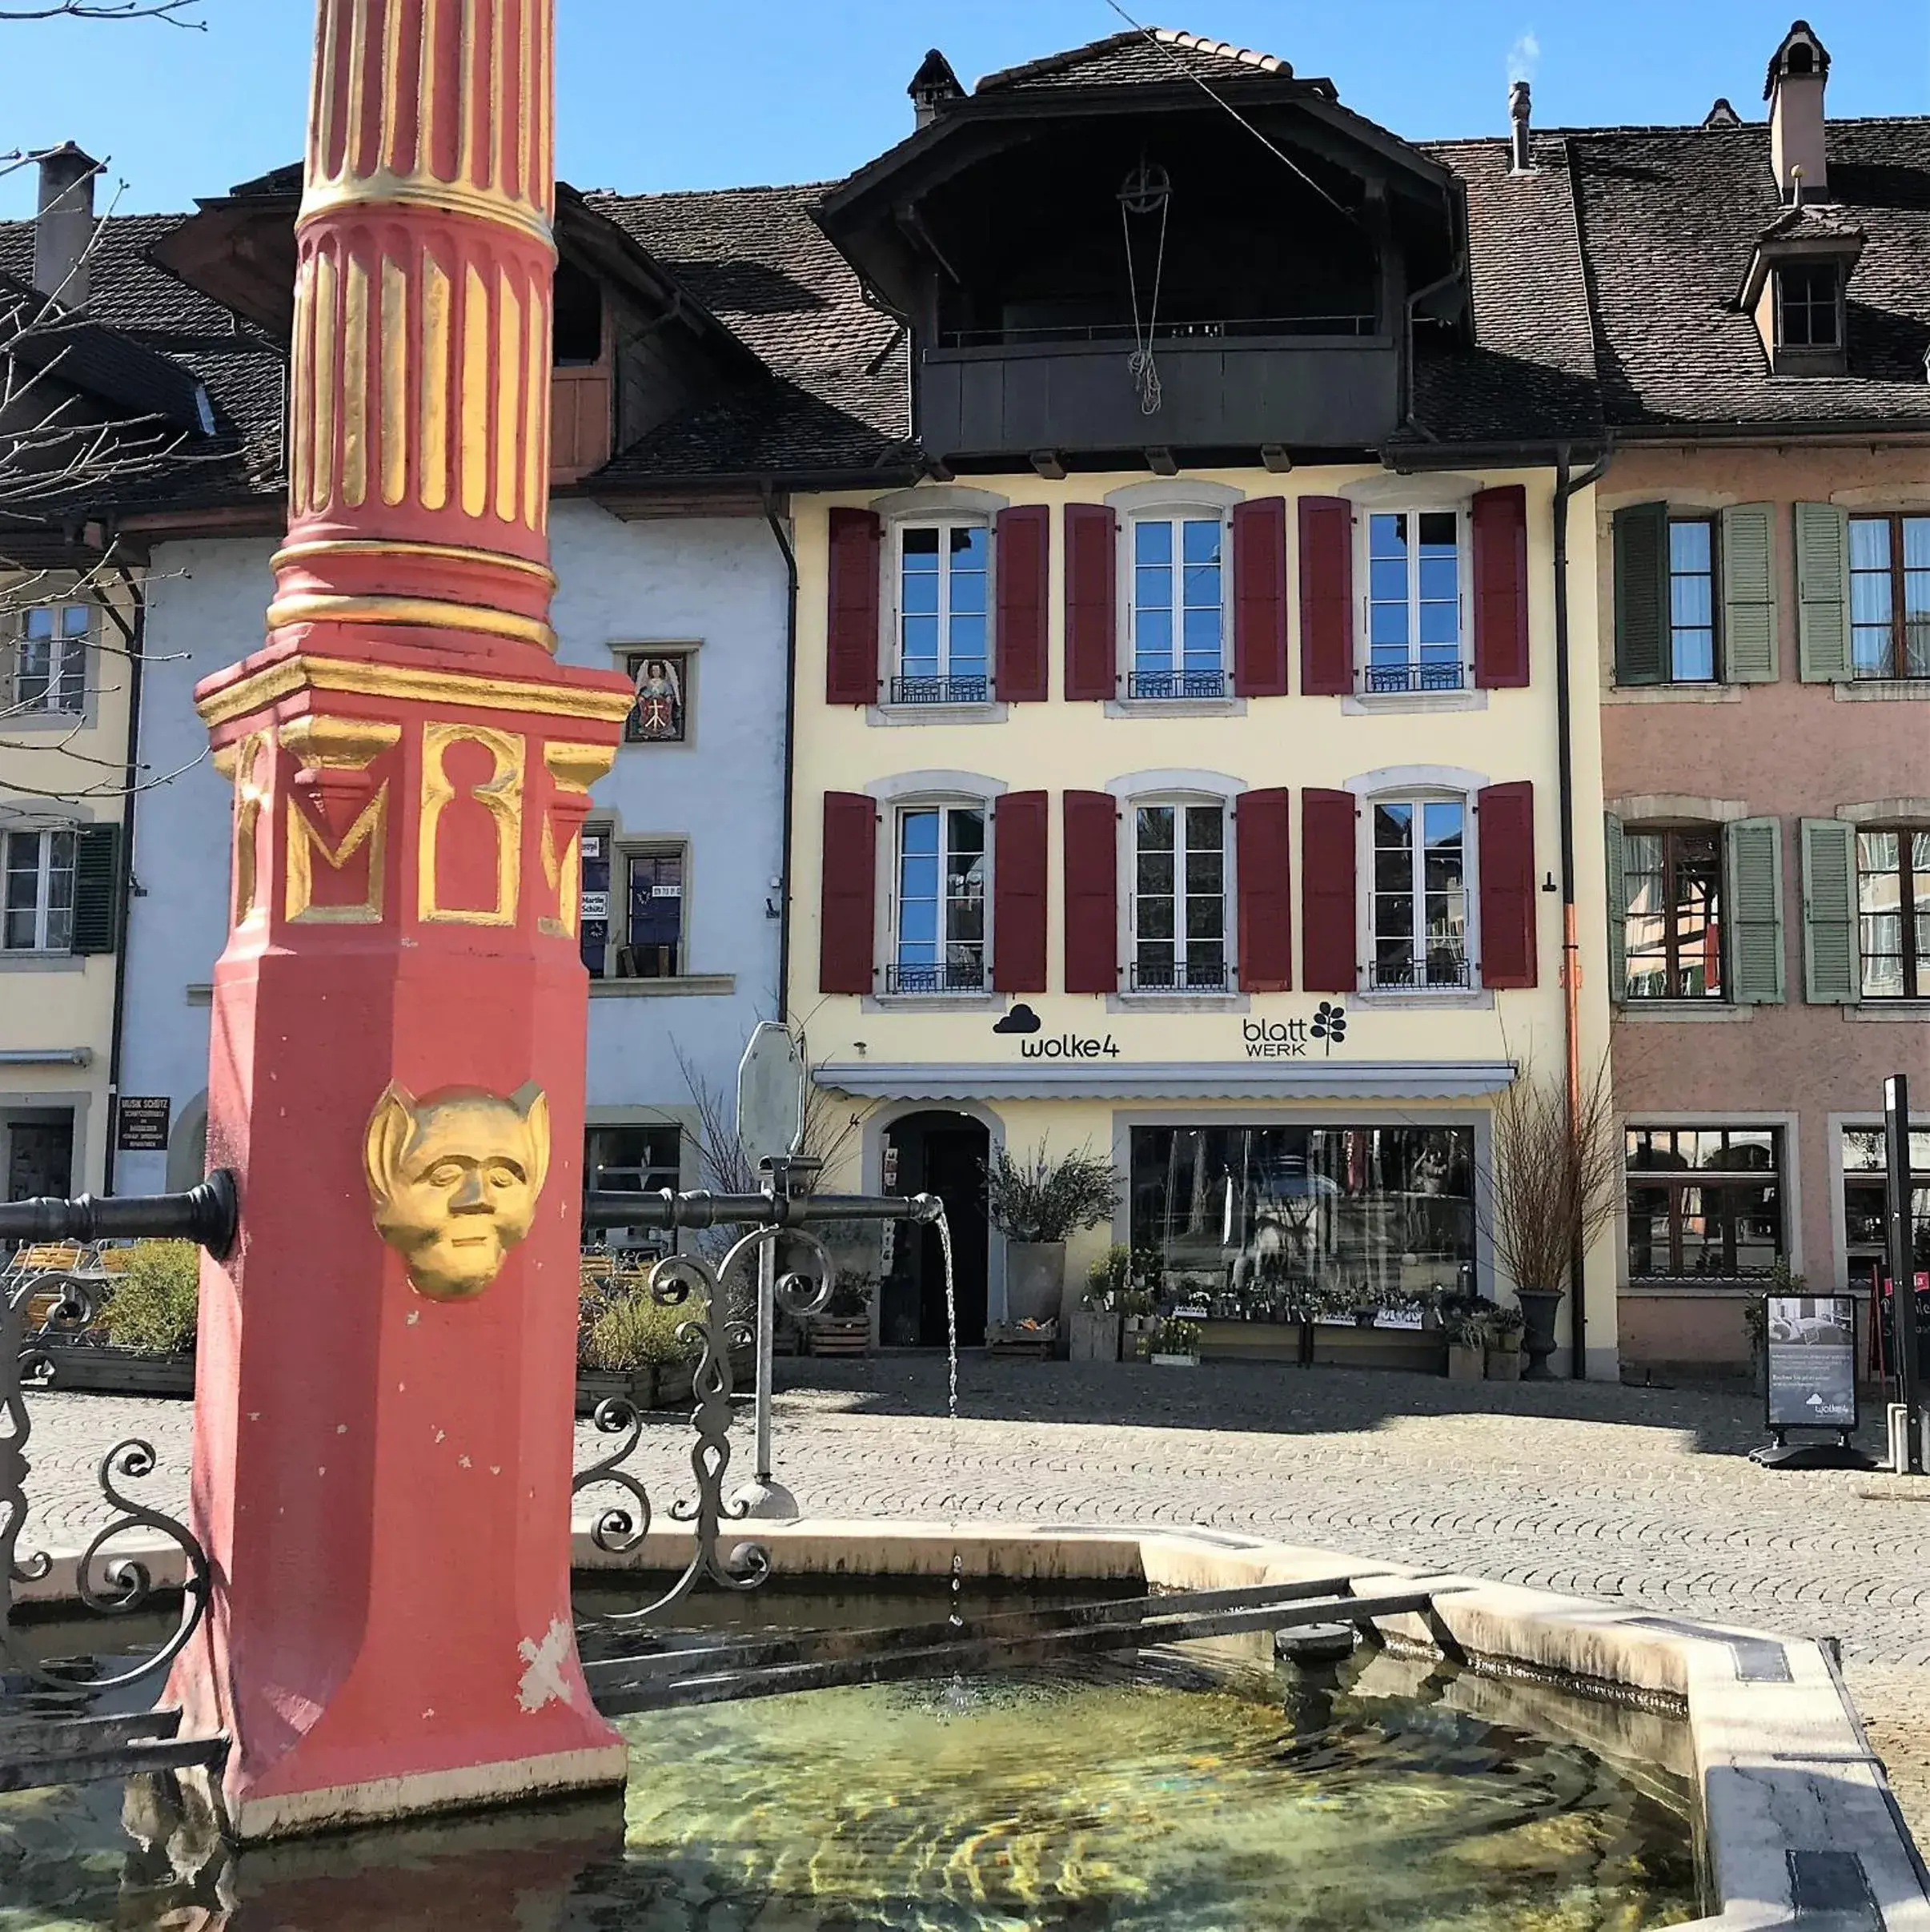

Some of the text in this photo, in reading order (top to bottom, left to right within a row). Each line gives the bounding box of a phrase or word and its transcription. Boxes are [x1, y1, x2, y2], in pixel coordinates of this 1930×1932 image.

[1243, 1018, 1307, 1042] blatt
[1021, 1034, 1120, 1058] wolke4
[1246, 1043, 1306, 1057] WERK
